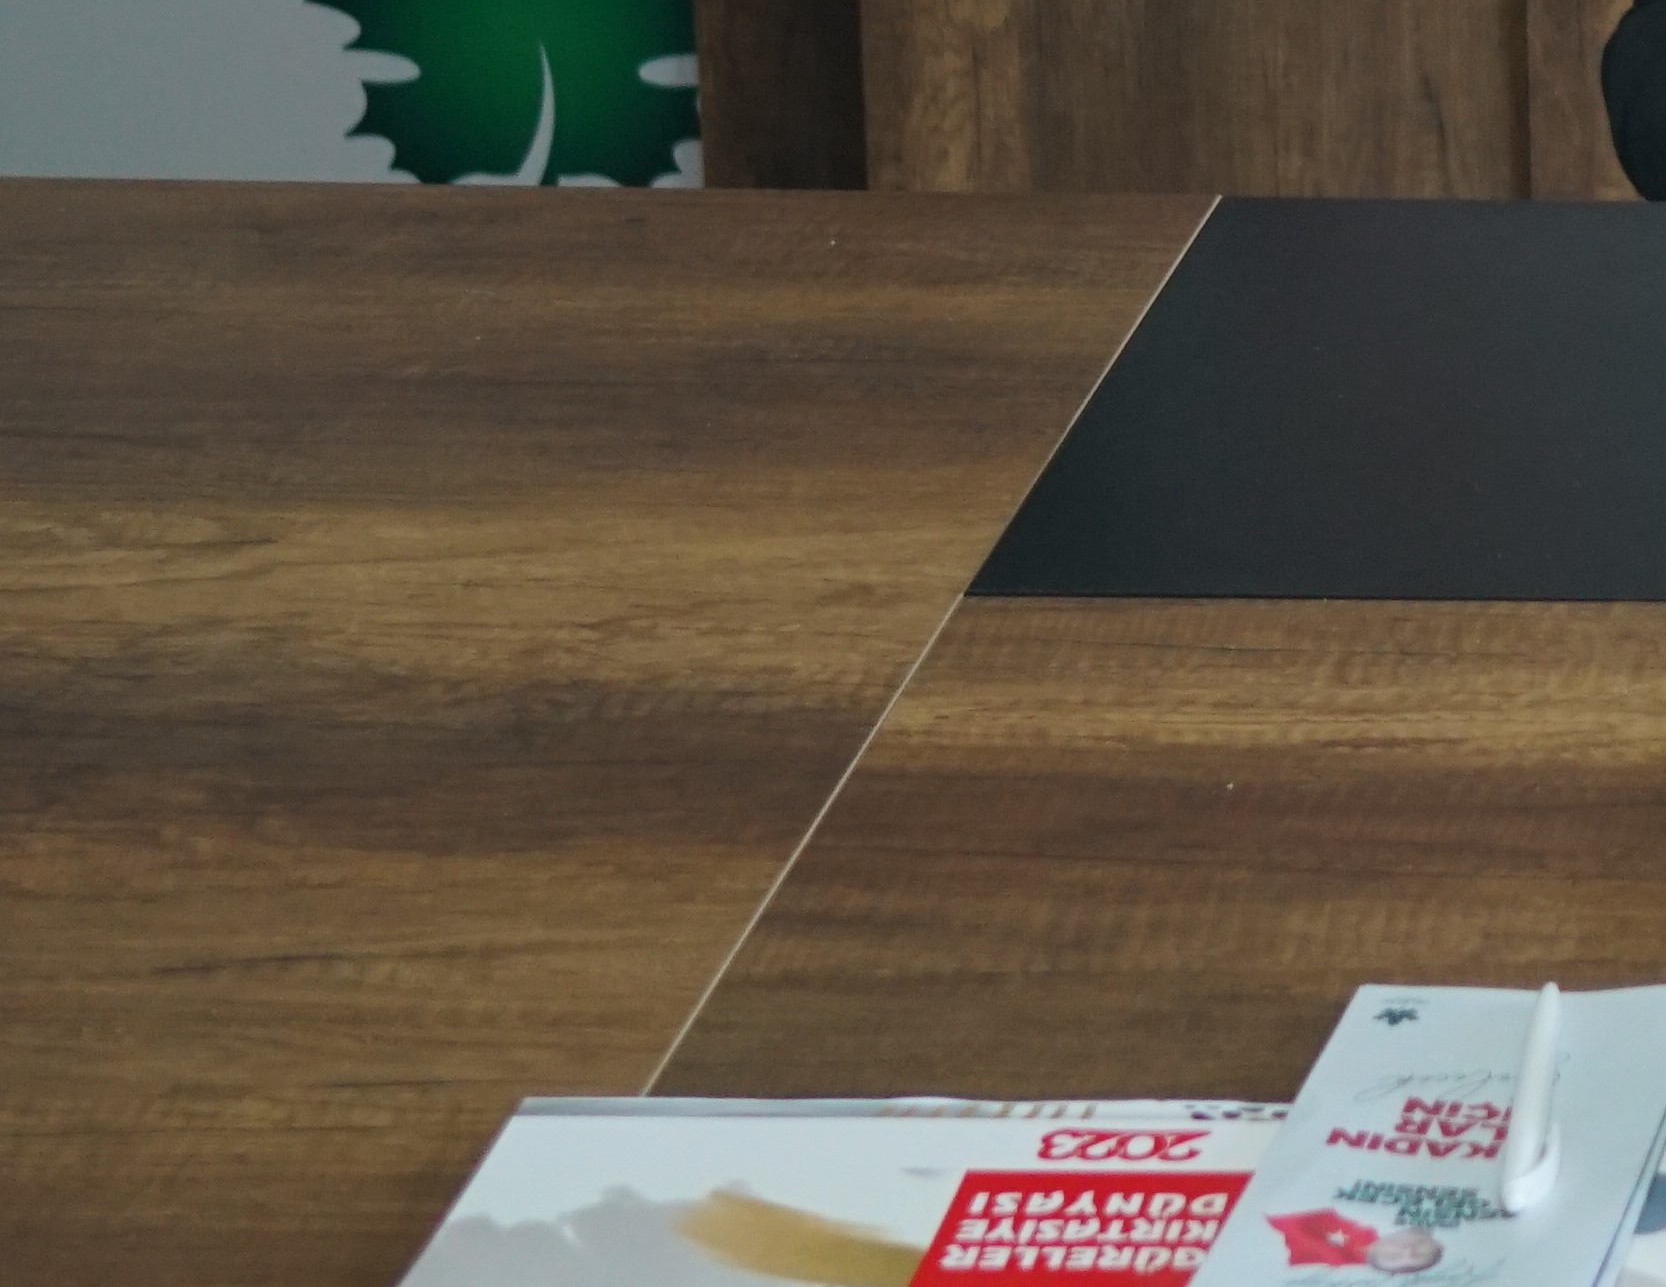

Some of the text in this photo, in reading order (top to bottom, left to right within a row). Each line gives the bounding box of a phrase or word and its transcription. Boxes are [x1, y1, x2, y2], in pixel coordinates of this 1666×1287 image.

[1036, 1126, 1211, 1161] 2023
[1326, 1127, 1500, 1158] KADIN
[965, 1190, 1229, 1219] DÜNYASI
[954, 1217, 1222, 1245] KIRTASİYE
